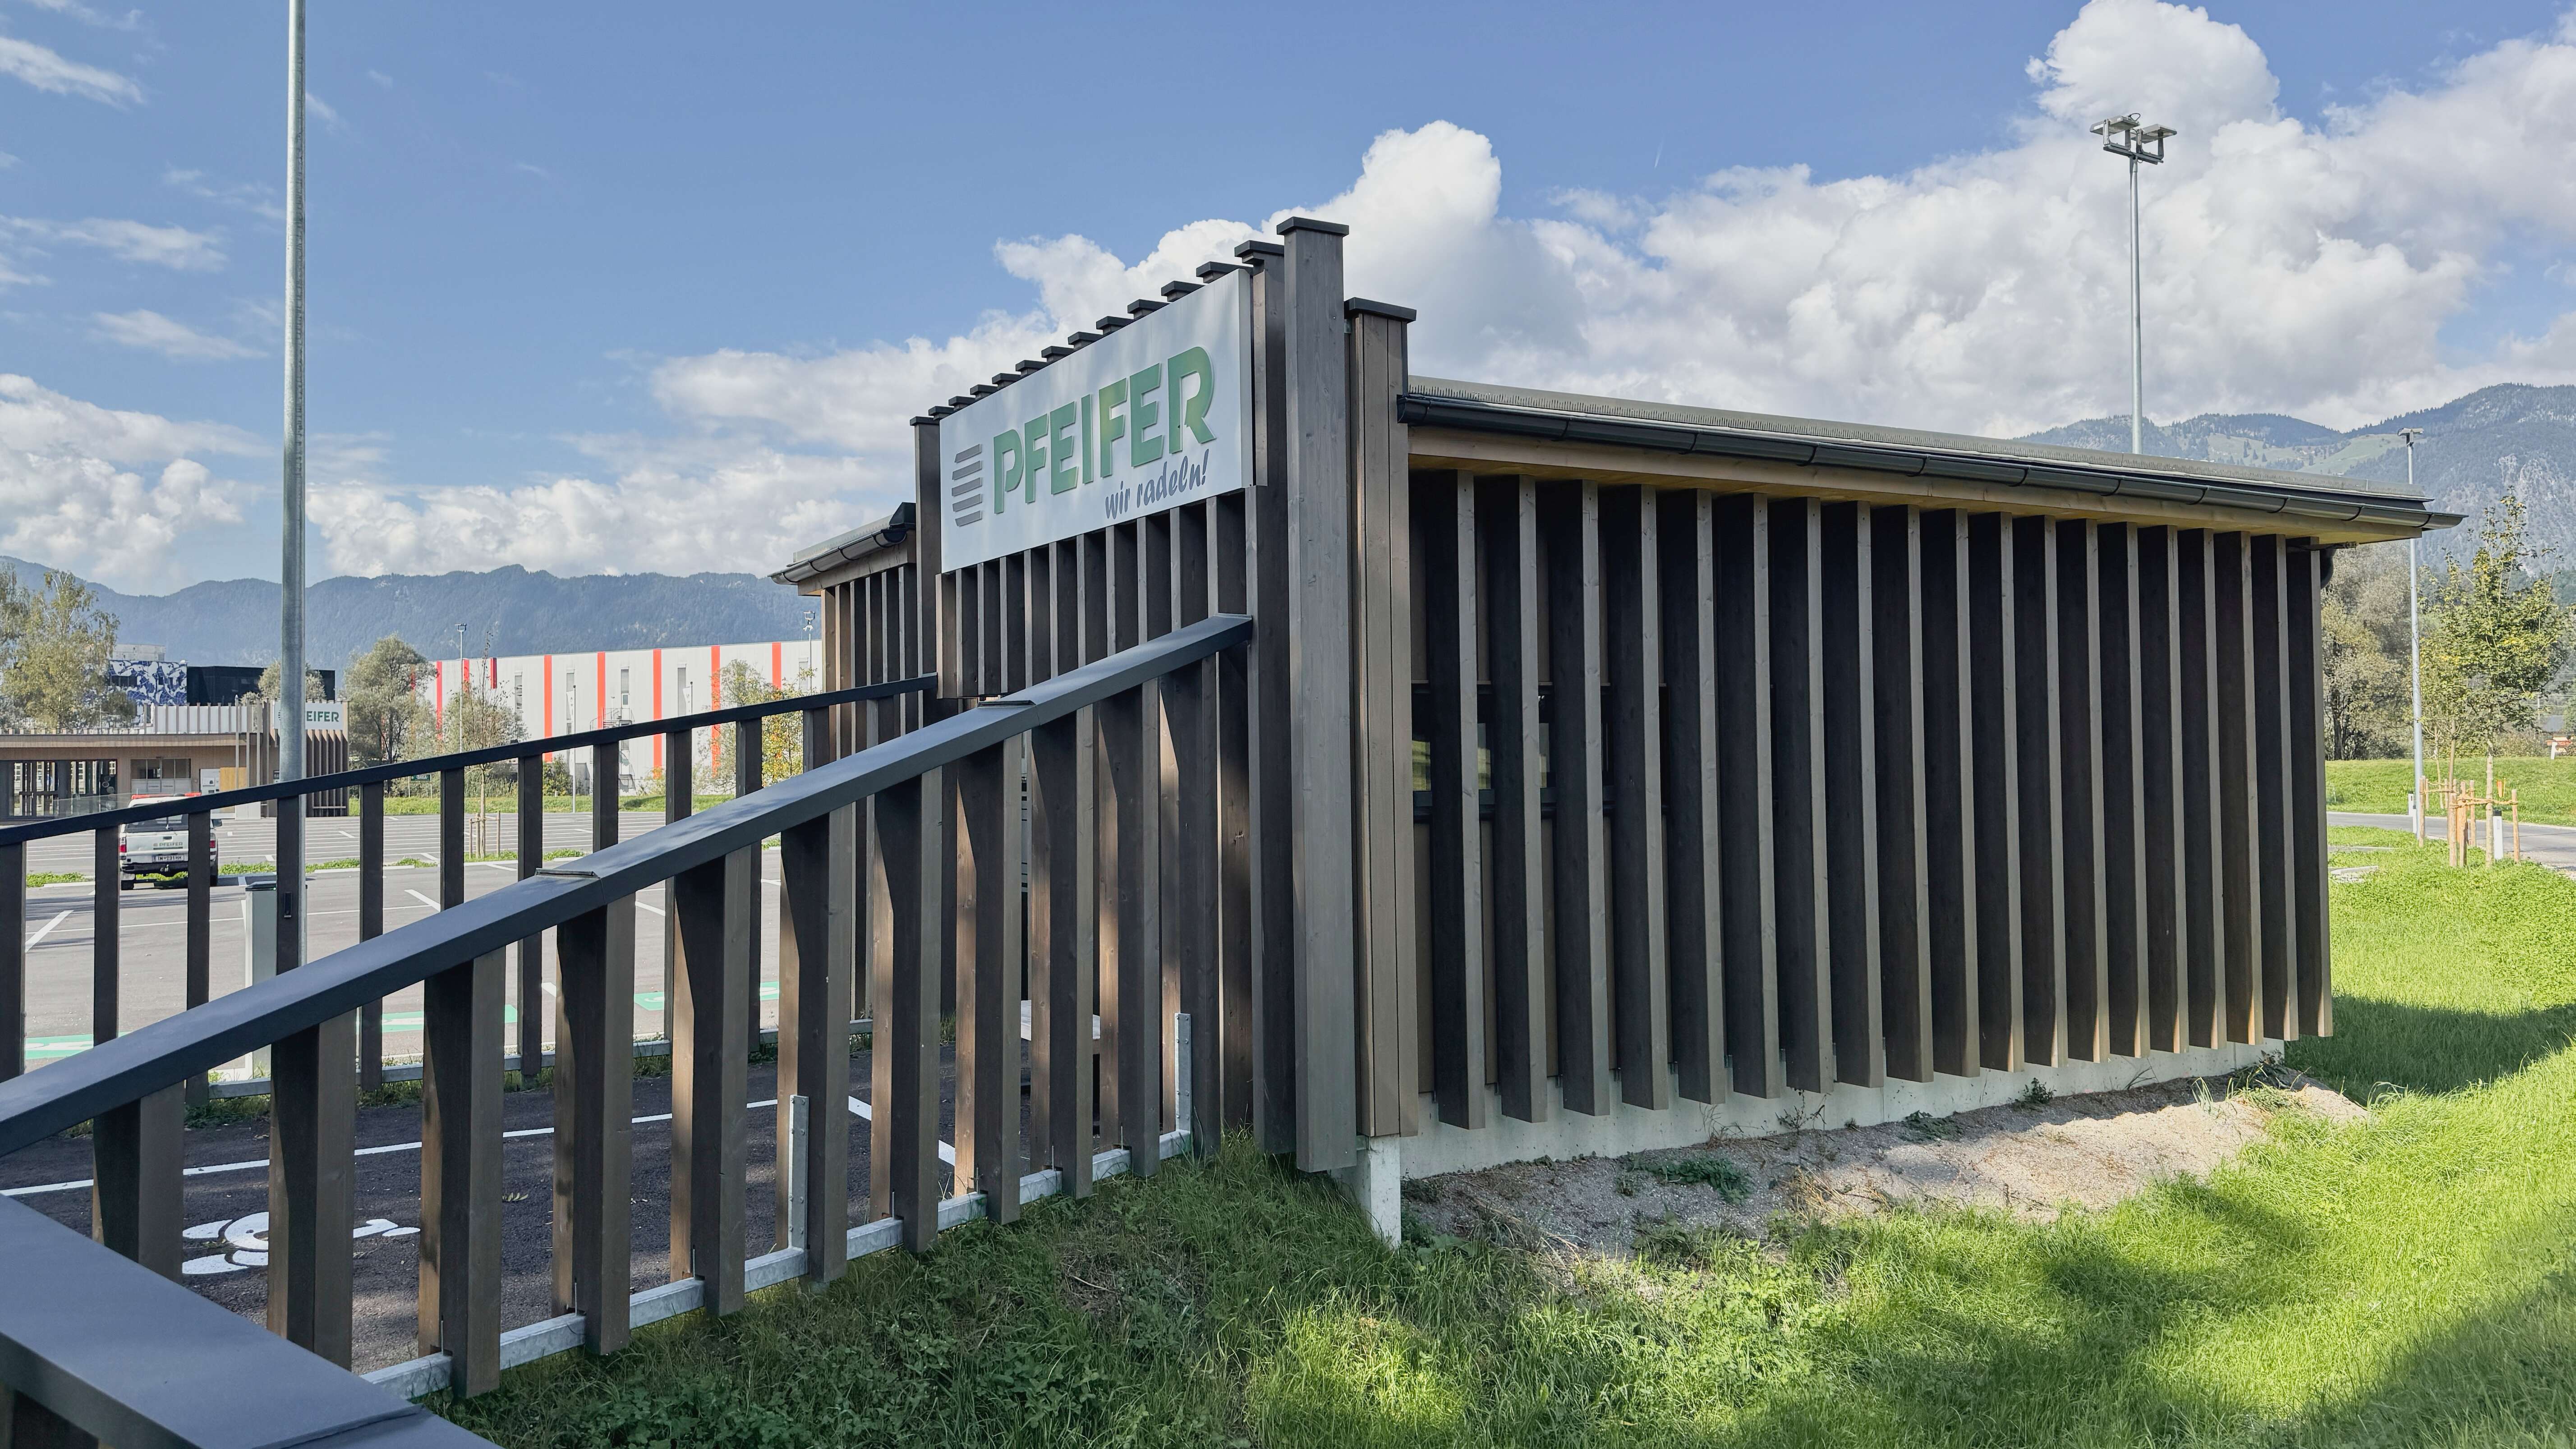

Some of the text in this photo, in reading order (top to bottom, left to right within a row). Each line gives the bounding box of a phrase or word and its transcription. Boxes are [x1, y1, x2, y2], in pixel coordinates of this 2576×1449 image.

[994, 346, 1217, 514] PFEIFER
[1105, 449, 1209, 520] wir radeln!
[306, 711, 340, 722] EIFER
